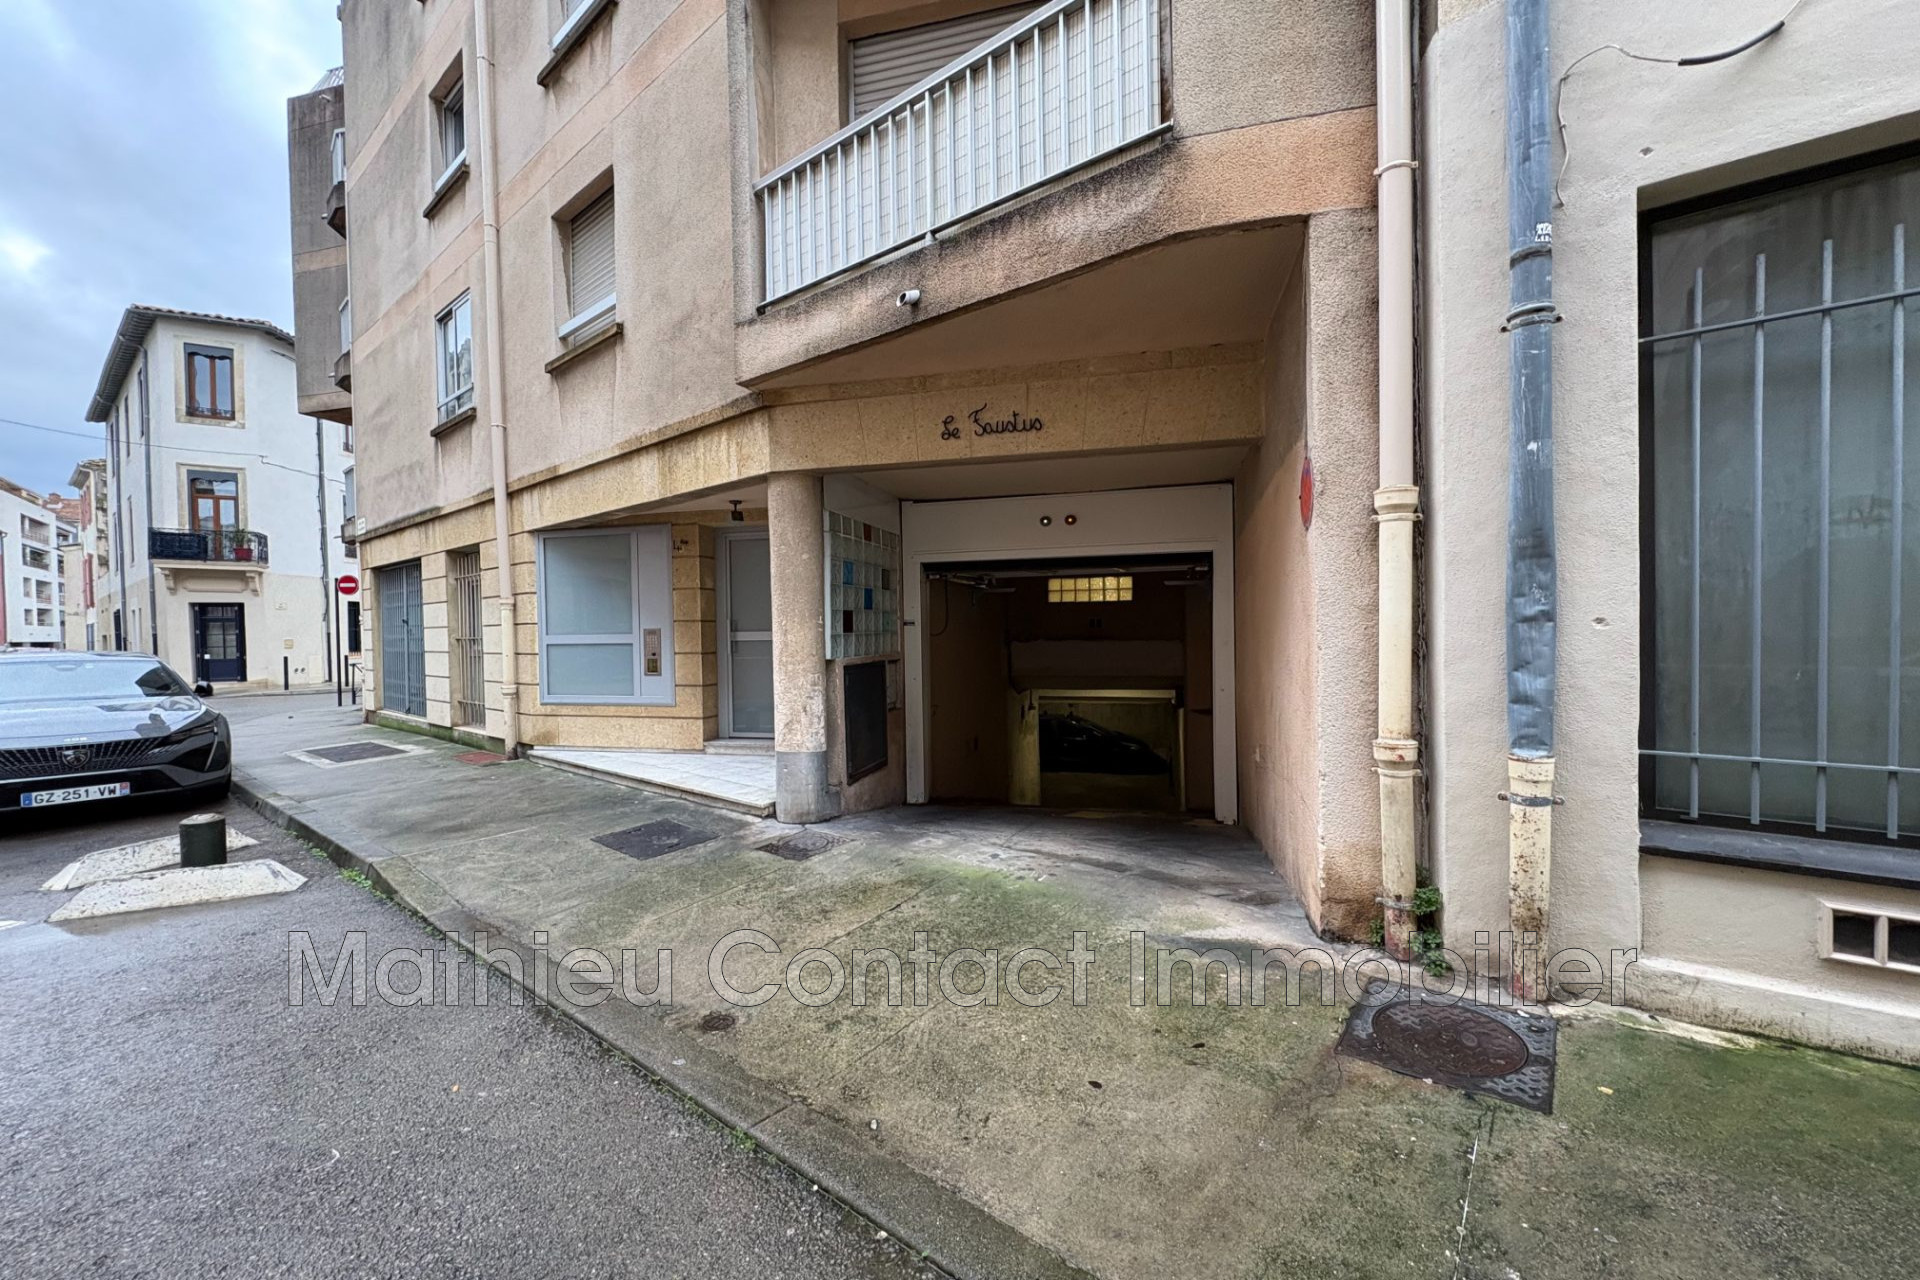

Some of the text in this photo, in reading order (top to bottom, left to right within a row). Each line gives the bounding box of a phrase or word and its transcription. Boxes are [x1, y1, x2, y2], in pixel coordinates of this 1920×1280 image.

[941, 403, 1043, 440] Le Faustus
[34, 785, 117, 804] GZ-251-VW
